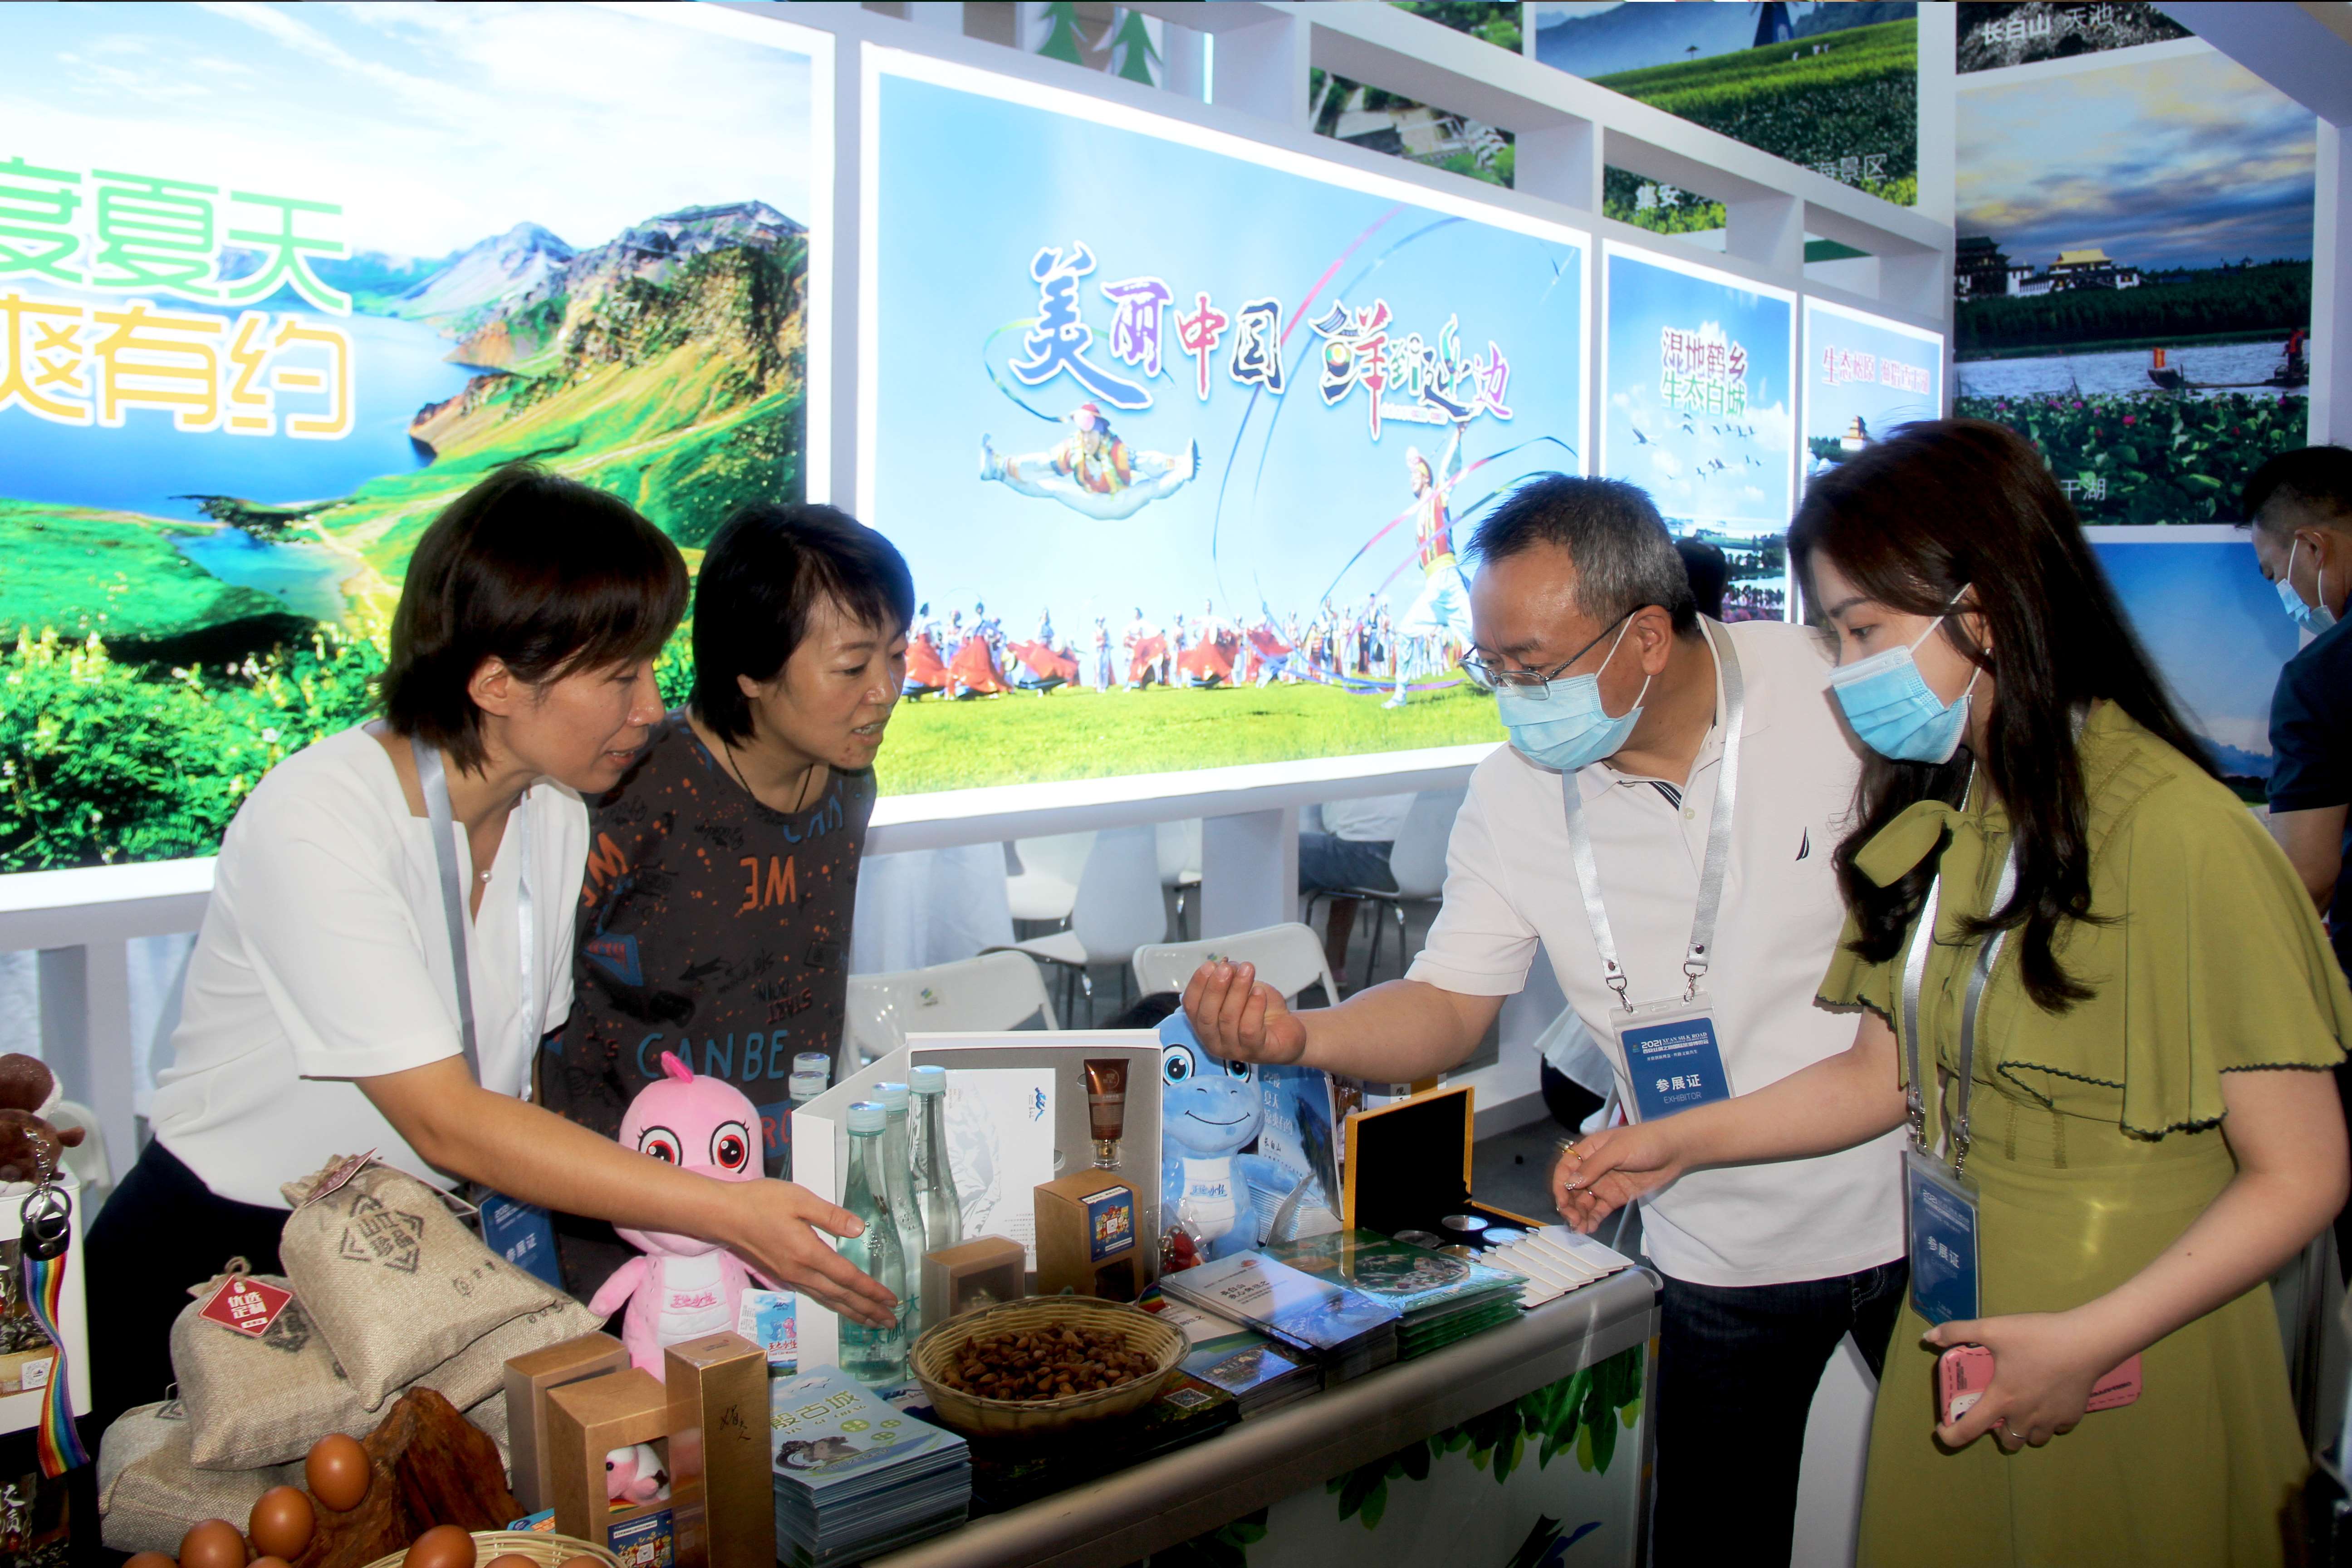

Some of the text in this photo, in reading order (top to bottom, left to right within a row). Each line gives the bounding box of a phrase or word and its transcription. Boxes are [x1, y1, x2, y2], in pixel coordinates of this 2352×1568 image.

[1980, 4, 2115, 45] 长白山 天池
[0, 156, 344, 311] 度夏天
[1008, 240, 1285, 410] 美丽中国
[1662, 369, 1746, 418] 生态白城
[1641, 1039, 1662, 1049] 2021
[1655, 1074, 1702, 1093] 参展证
[1663, 1092, 1702, 1104] EXHIBITOR
[1927, 1235, 1960, 1270] 参展证
